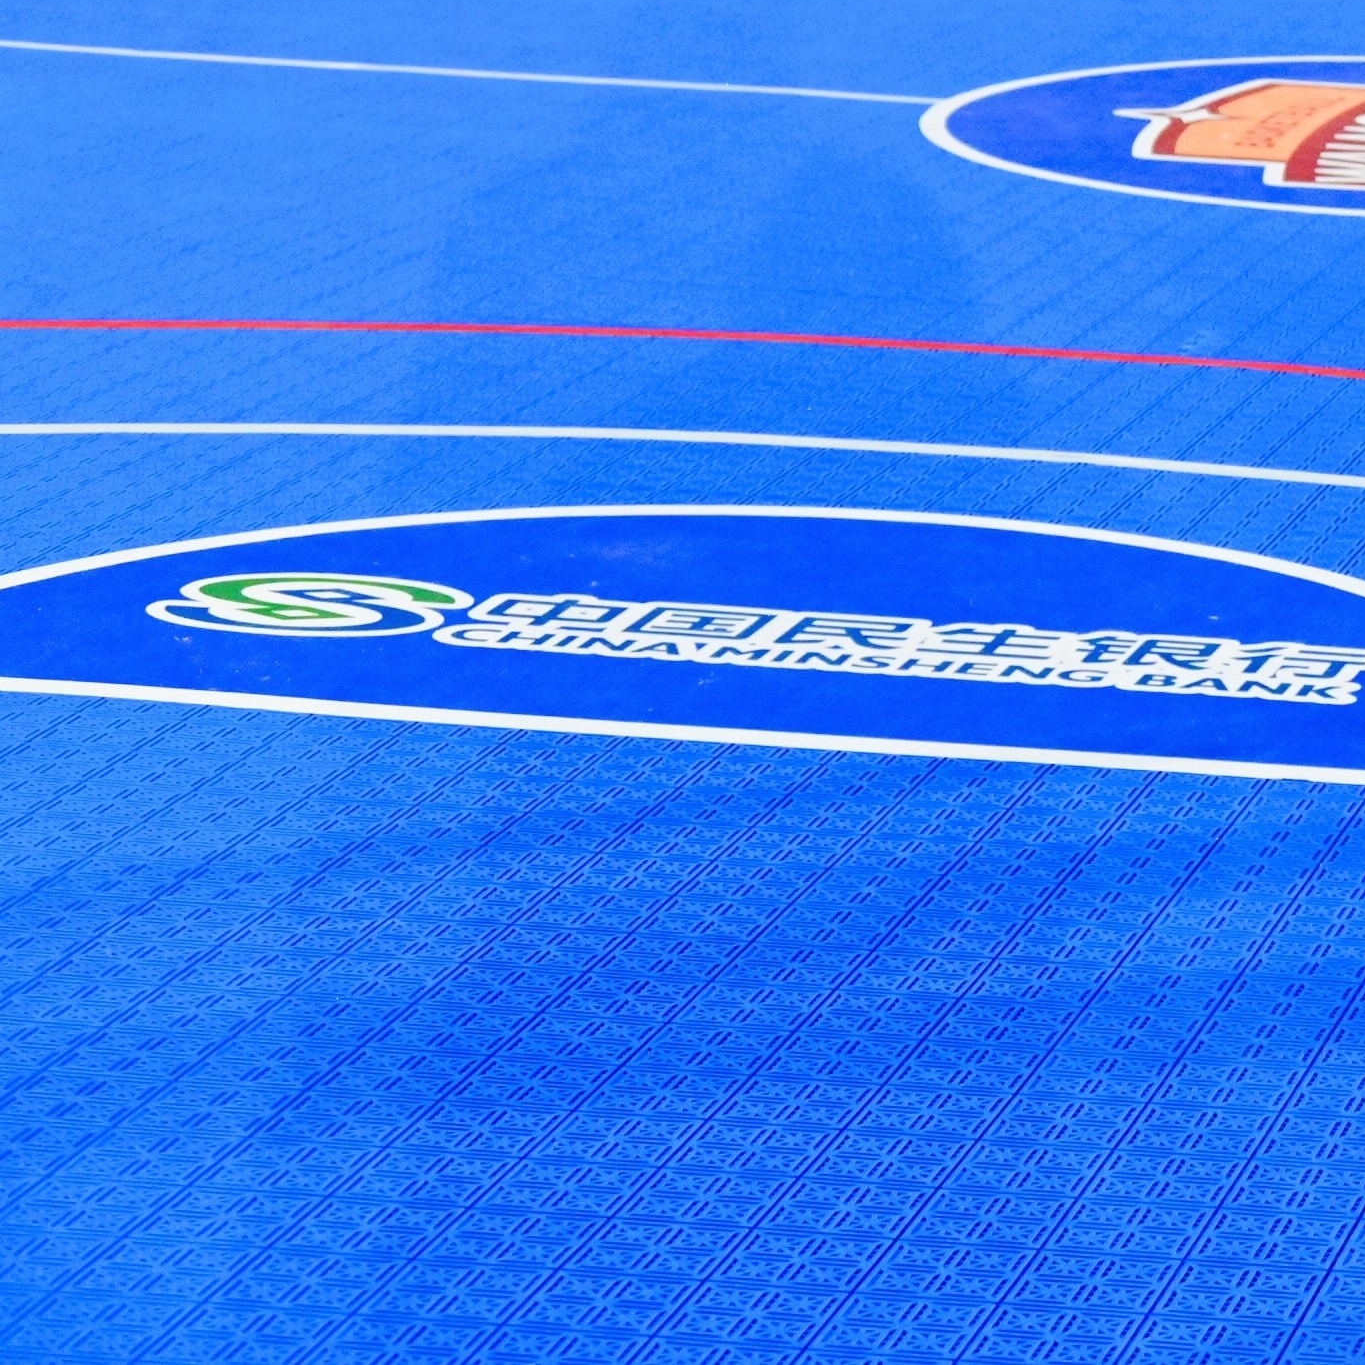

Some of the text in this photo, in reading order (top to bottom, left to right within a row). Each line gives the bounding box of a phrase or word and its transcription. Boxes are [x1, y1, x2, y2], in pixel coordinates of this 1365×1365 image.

[448, 627, 1350, 701] CHINA MINSHENG BANK
